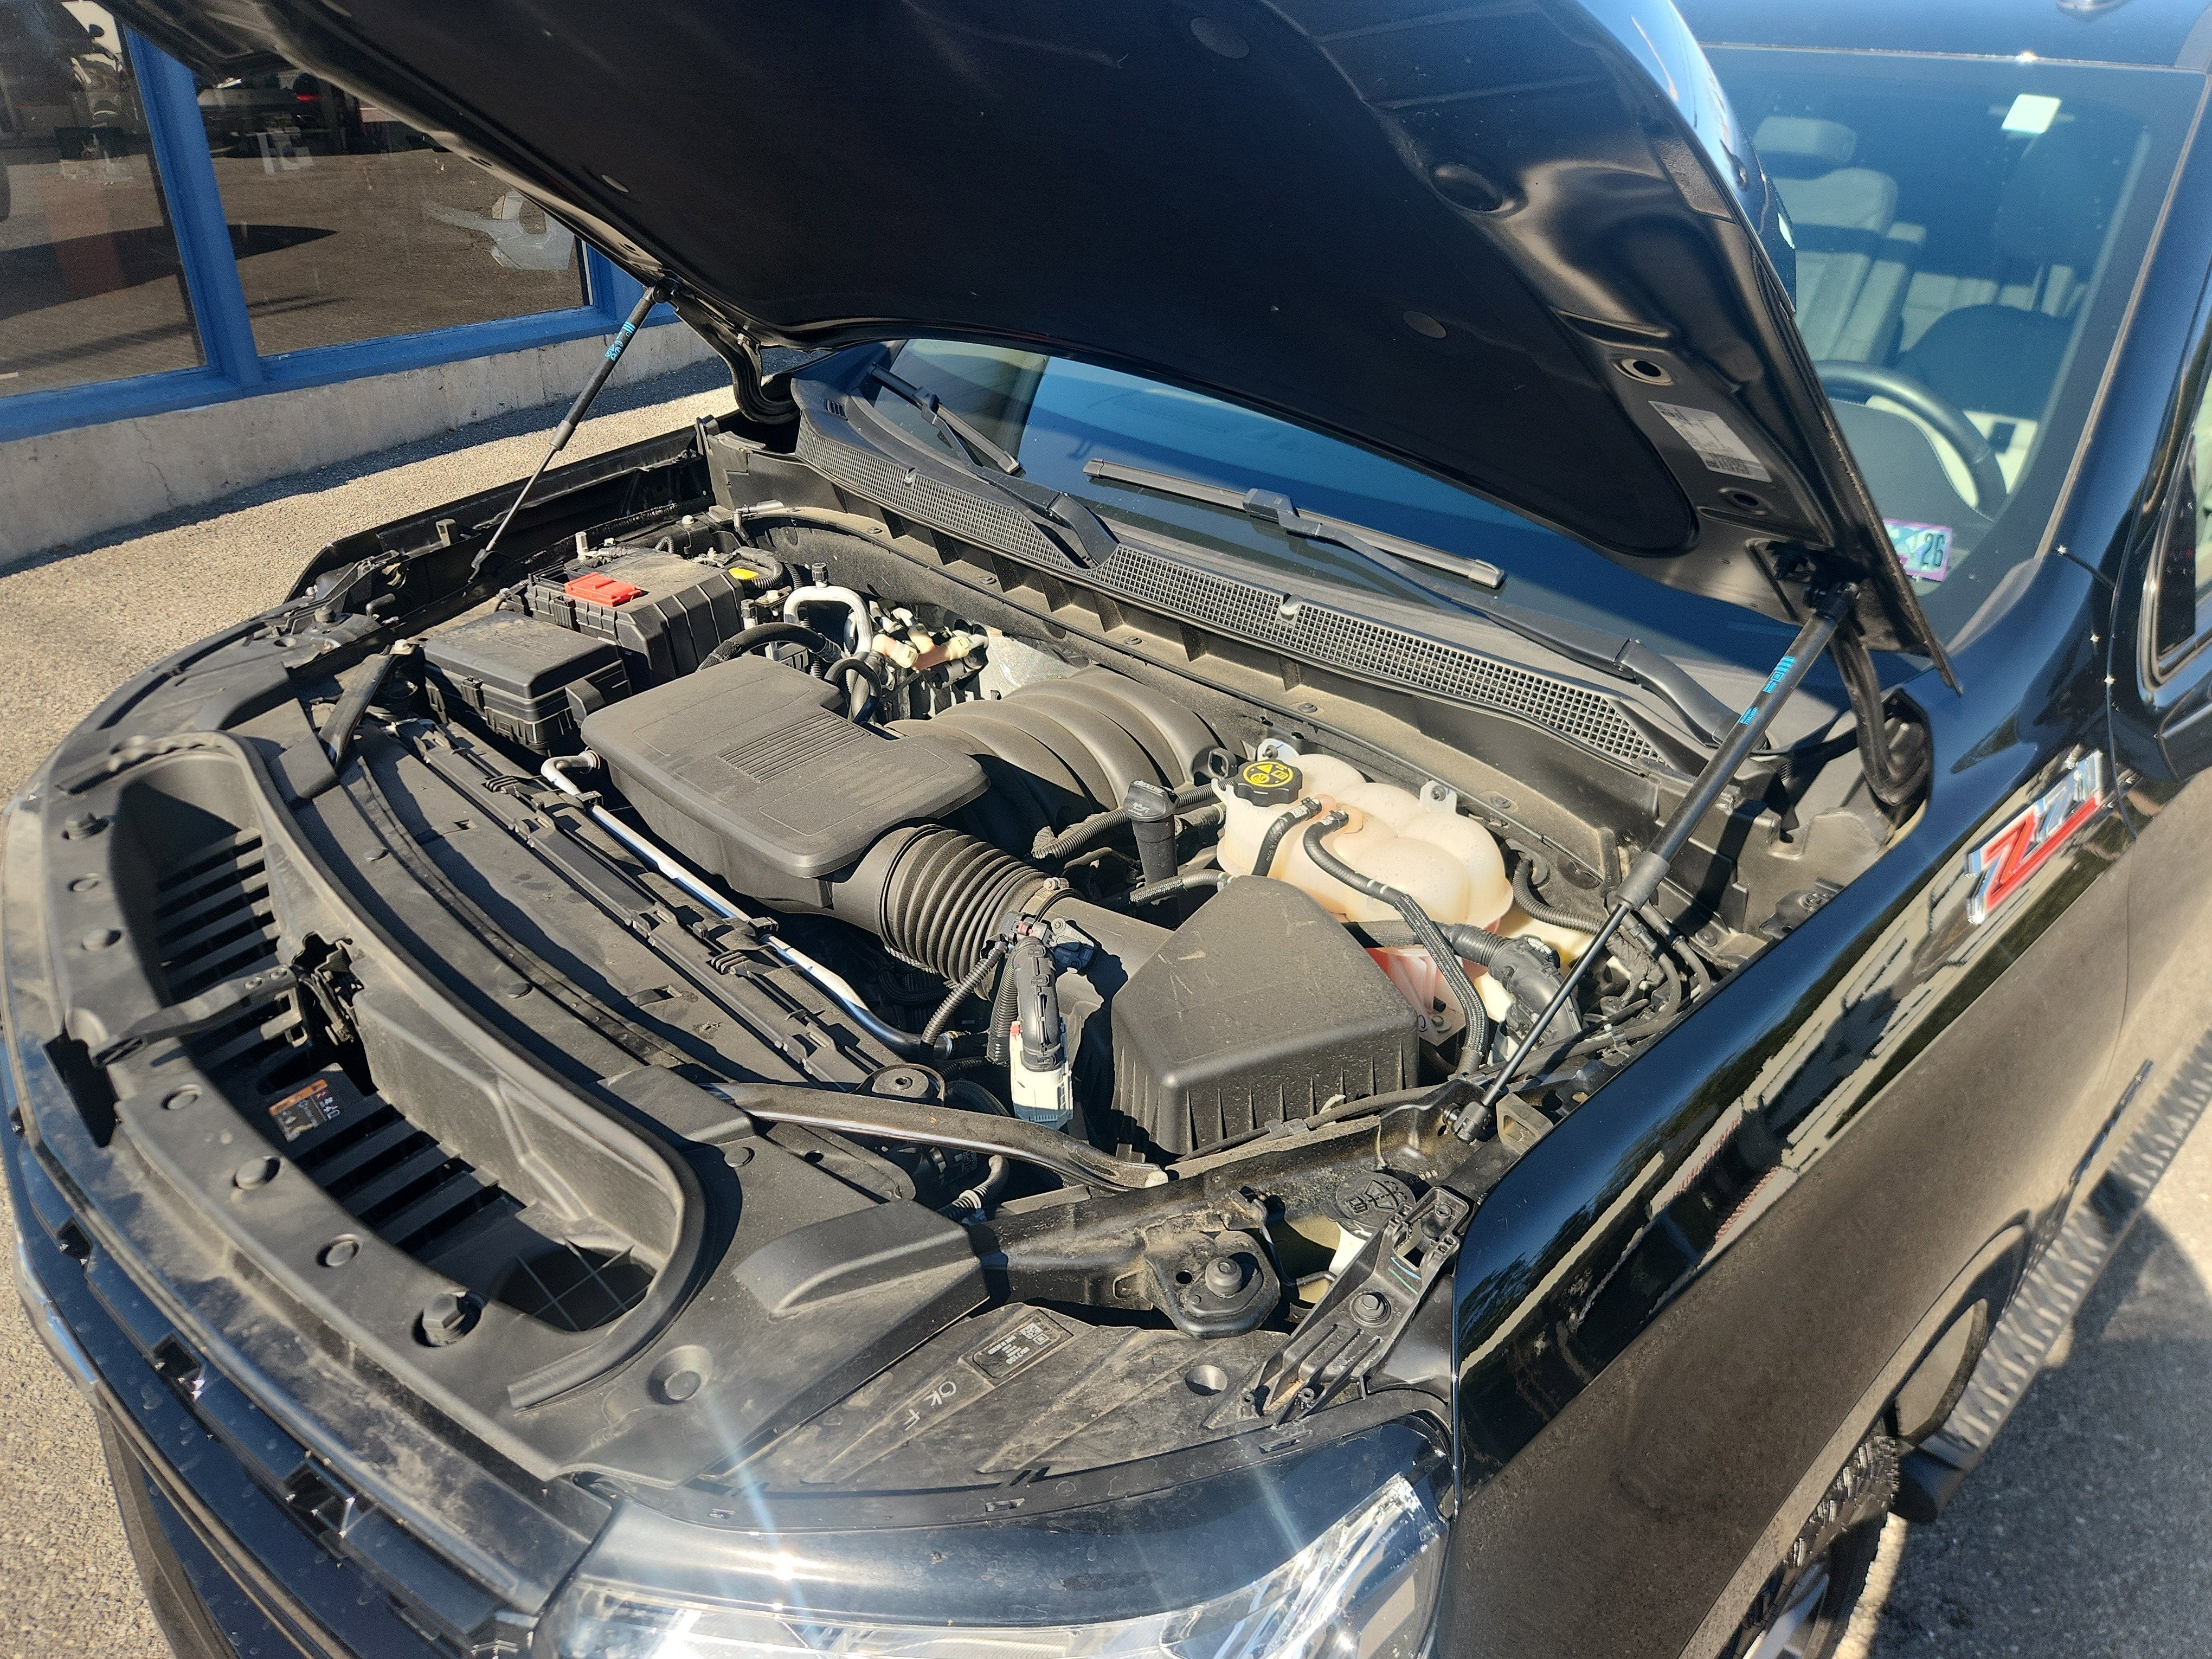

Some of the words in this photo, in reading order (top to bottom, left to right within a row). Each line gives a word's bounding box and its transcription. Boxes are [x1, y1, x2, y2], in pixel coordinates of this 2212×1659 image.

[1921, 533, 1945, 567] 26
[1133, 780, 1165, 794] dexos
[1964, 749, 2104, 924] Z71
[922, 1381, 957, 1406] OK
